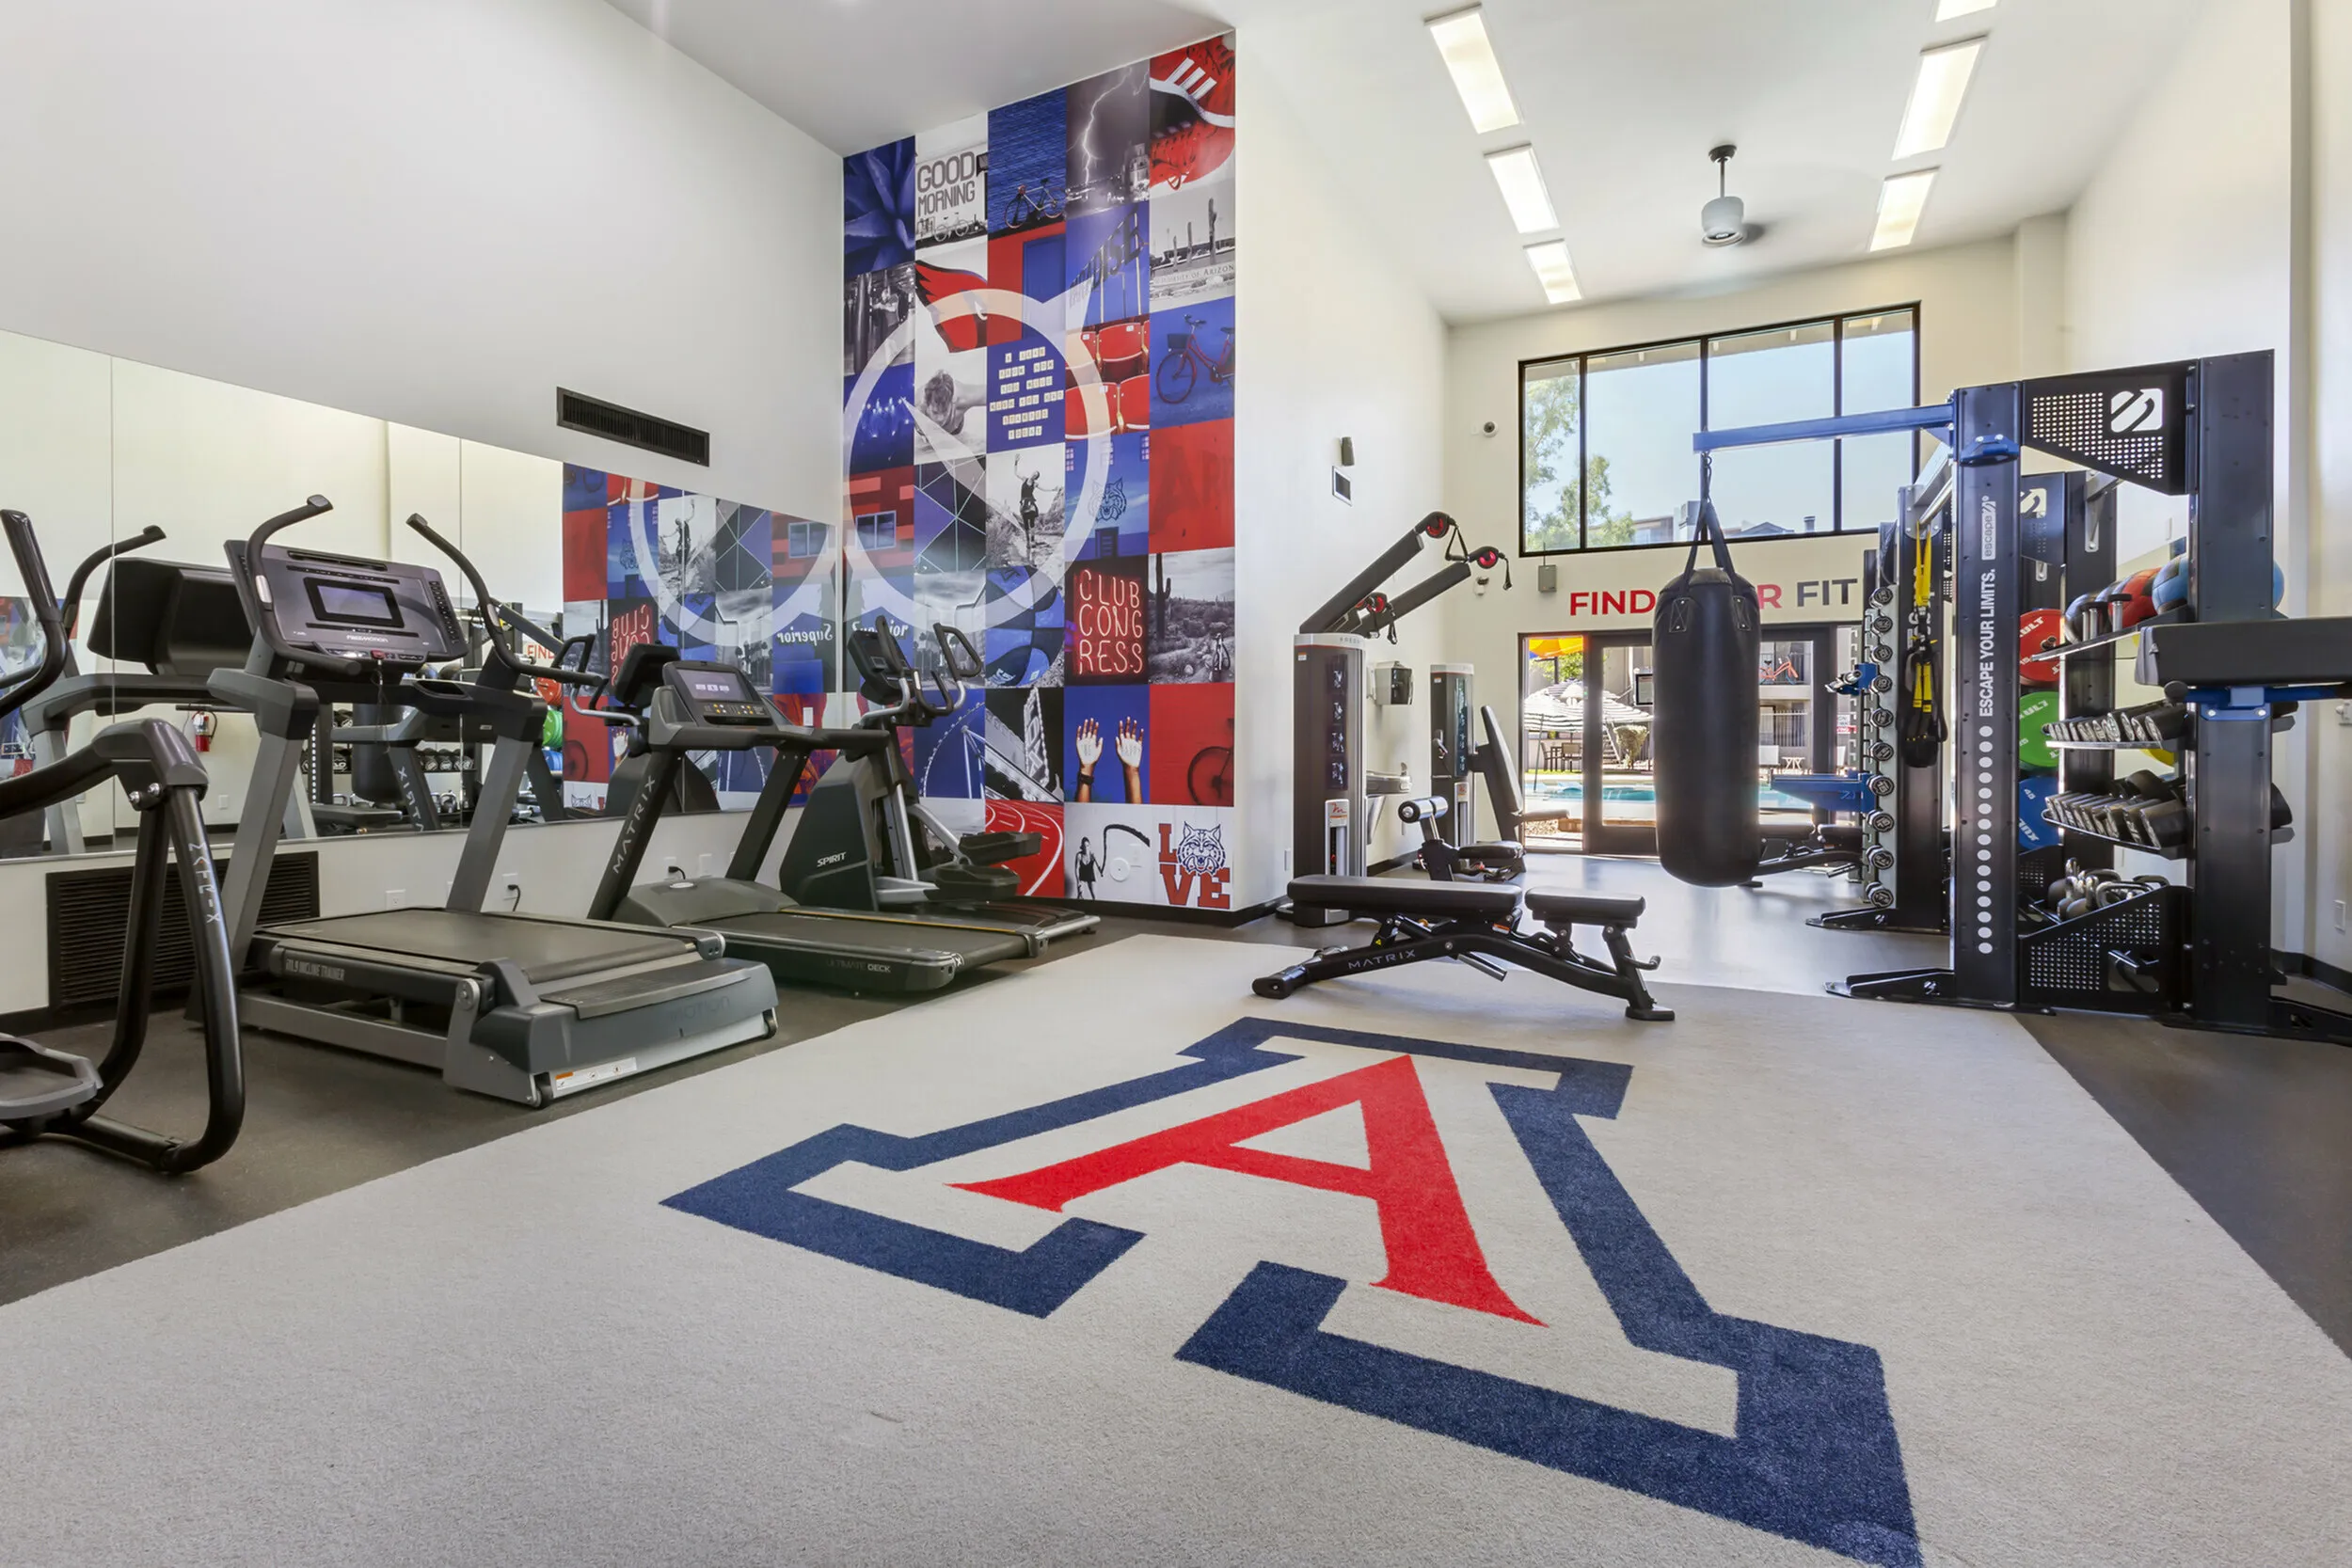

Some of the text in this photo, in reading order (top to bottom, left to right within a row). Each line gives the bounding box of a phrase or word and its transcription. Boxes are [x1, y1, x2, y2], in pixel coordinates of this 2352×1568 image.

[916, 151, 976, 193] GOOD
[917, 181, 976, 217] MORNING
[1983, 514, 1994, 557] escape
[1079, 569, 1140, 609] CLUB
[1569, 589, 1656, 616] FIND
[1797, 578, 1858, 608] FIT
[1079, 603, 1143, 638] CONG
[2019, 616, 2044, 638] ULT
[1078, 639, 1143, 675] RESS
[1979, 568, 1995, 717] ESCAPE YOUR LIMITS.
[2019, 699, 2049, 720] ULT
[612, 774, 656, 875] MATRIX
[817, 851, 847, 867] SPIRIT
[867, 963, 891, 974] DECK
[1347, 949, 1416, 970] MATRIX
